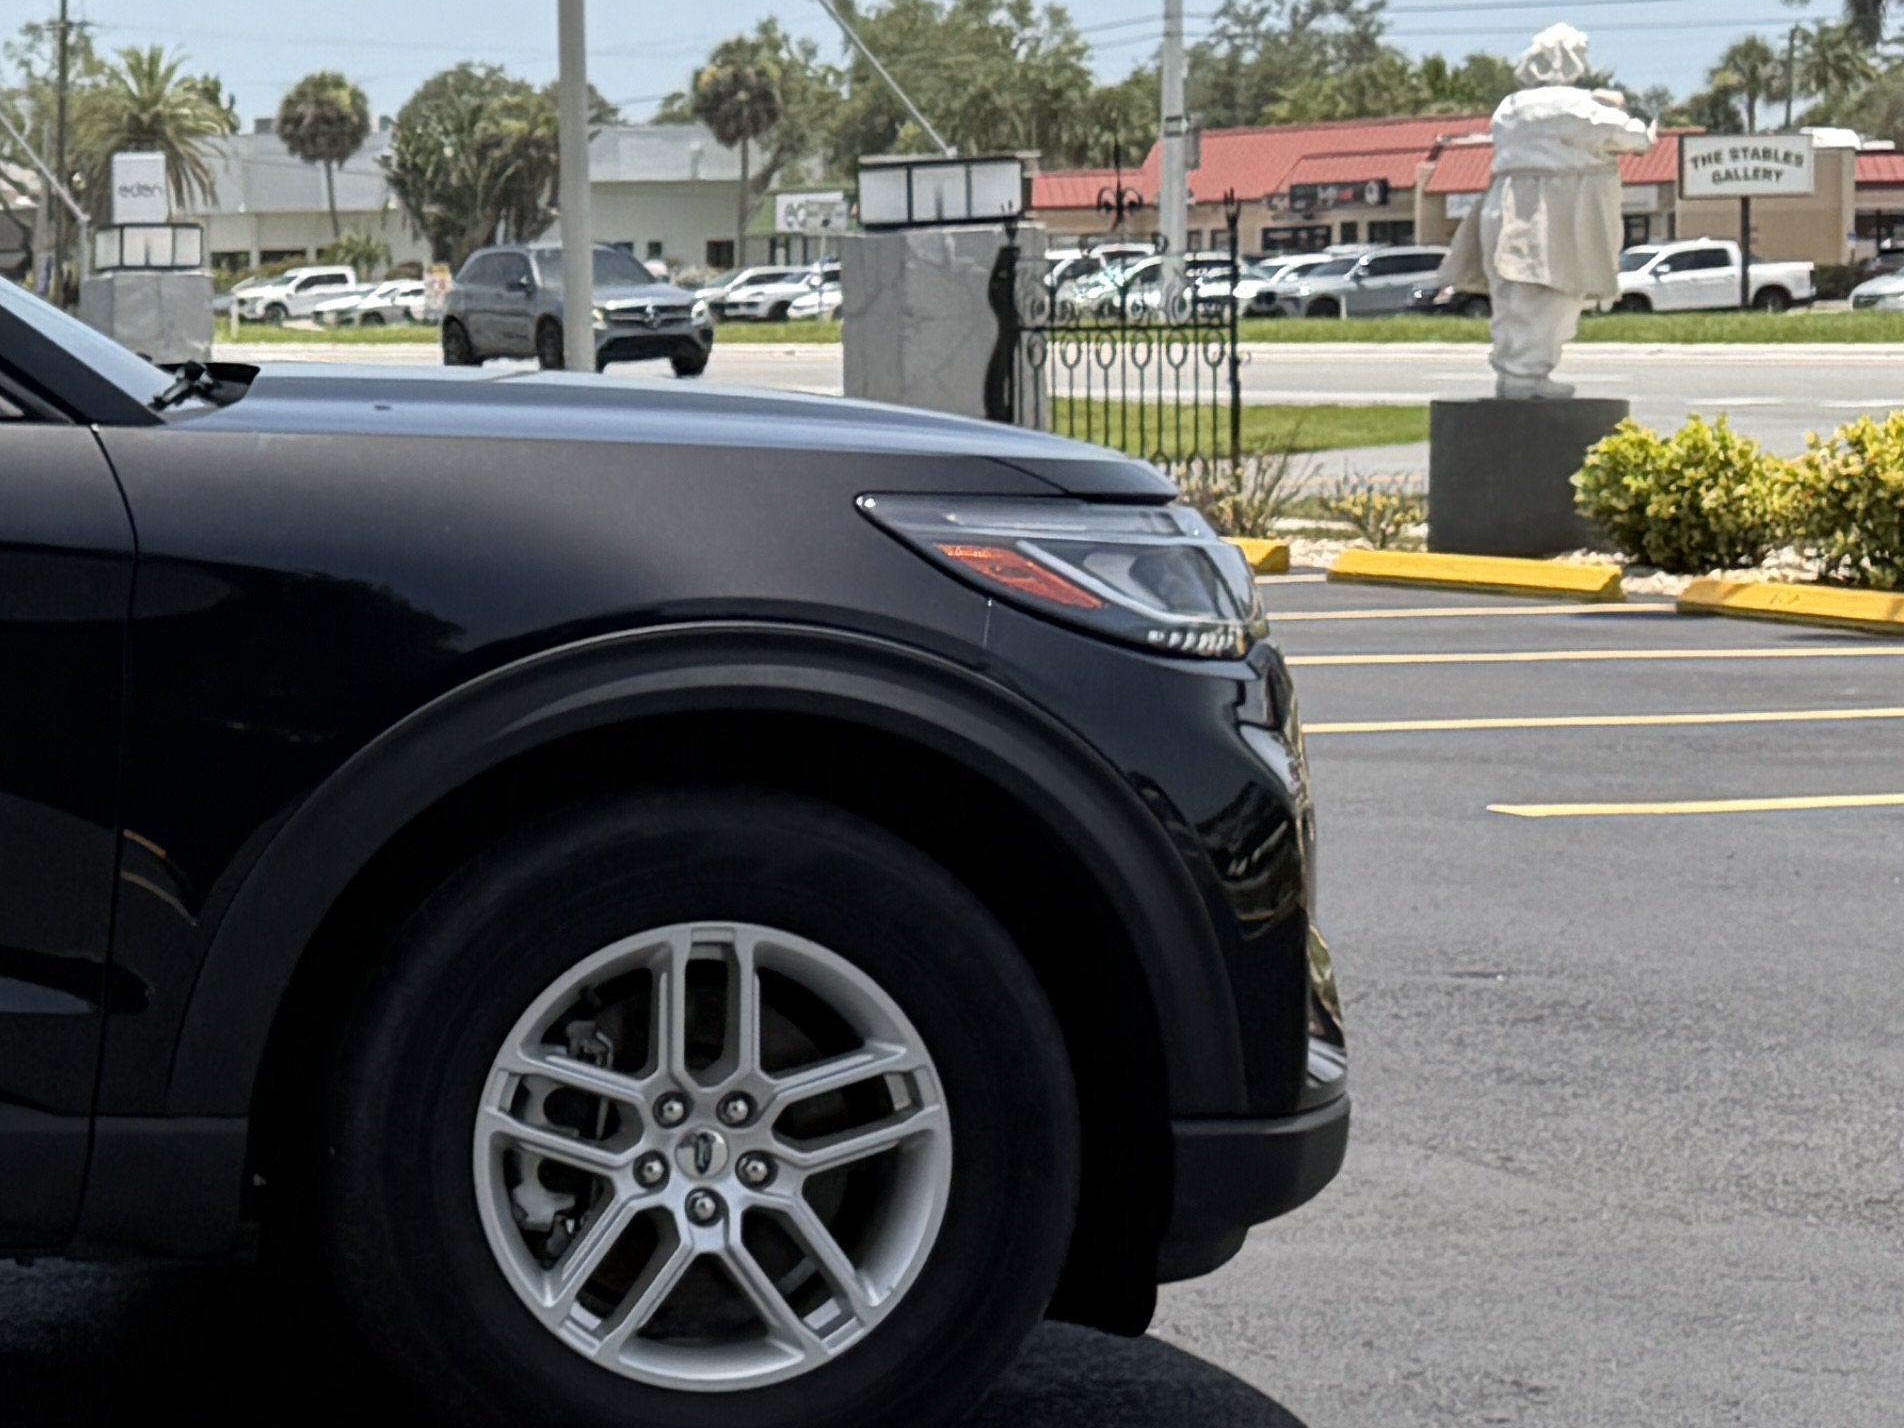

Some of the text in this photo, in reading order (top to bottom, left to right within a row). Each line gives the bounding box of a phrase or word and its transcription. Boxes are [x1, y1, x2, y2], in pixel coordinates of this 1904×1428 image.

[1691, 146, 1804, 170] THE STABLES
[1712, 167, 1783, 185] GALLERY
